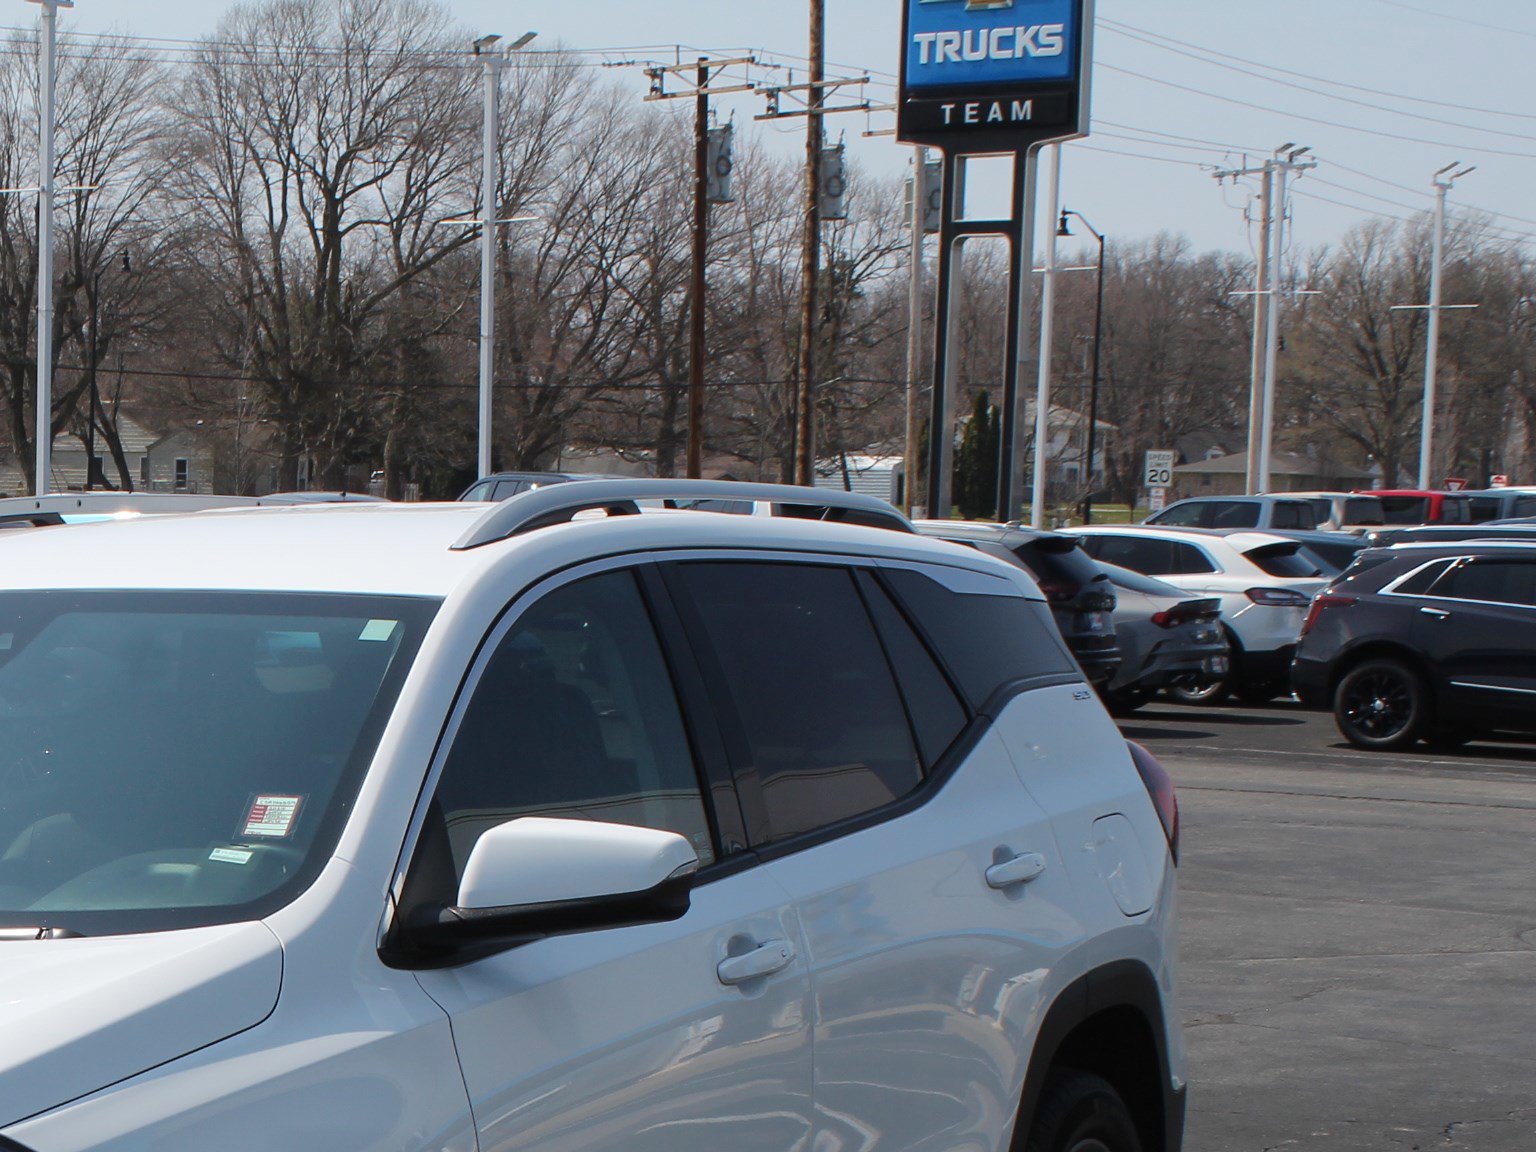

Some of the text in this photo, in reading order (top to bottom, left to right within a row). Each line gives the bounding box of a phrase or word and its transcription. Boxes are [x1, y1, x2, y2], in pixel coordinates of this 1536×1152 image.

[913, 23, 1064, 65] TRUCKS
[941, 100, 1033, 124] TEAM
[1148, 469, 1170, 483] 20
